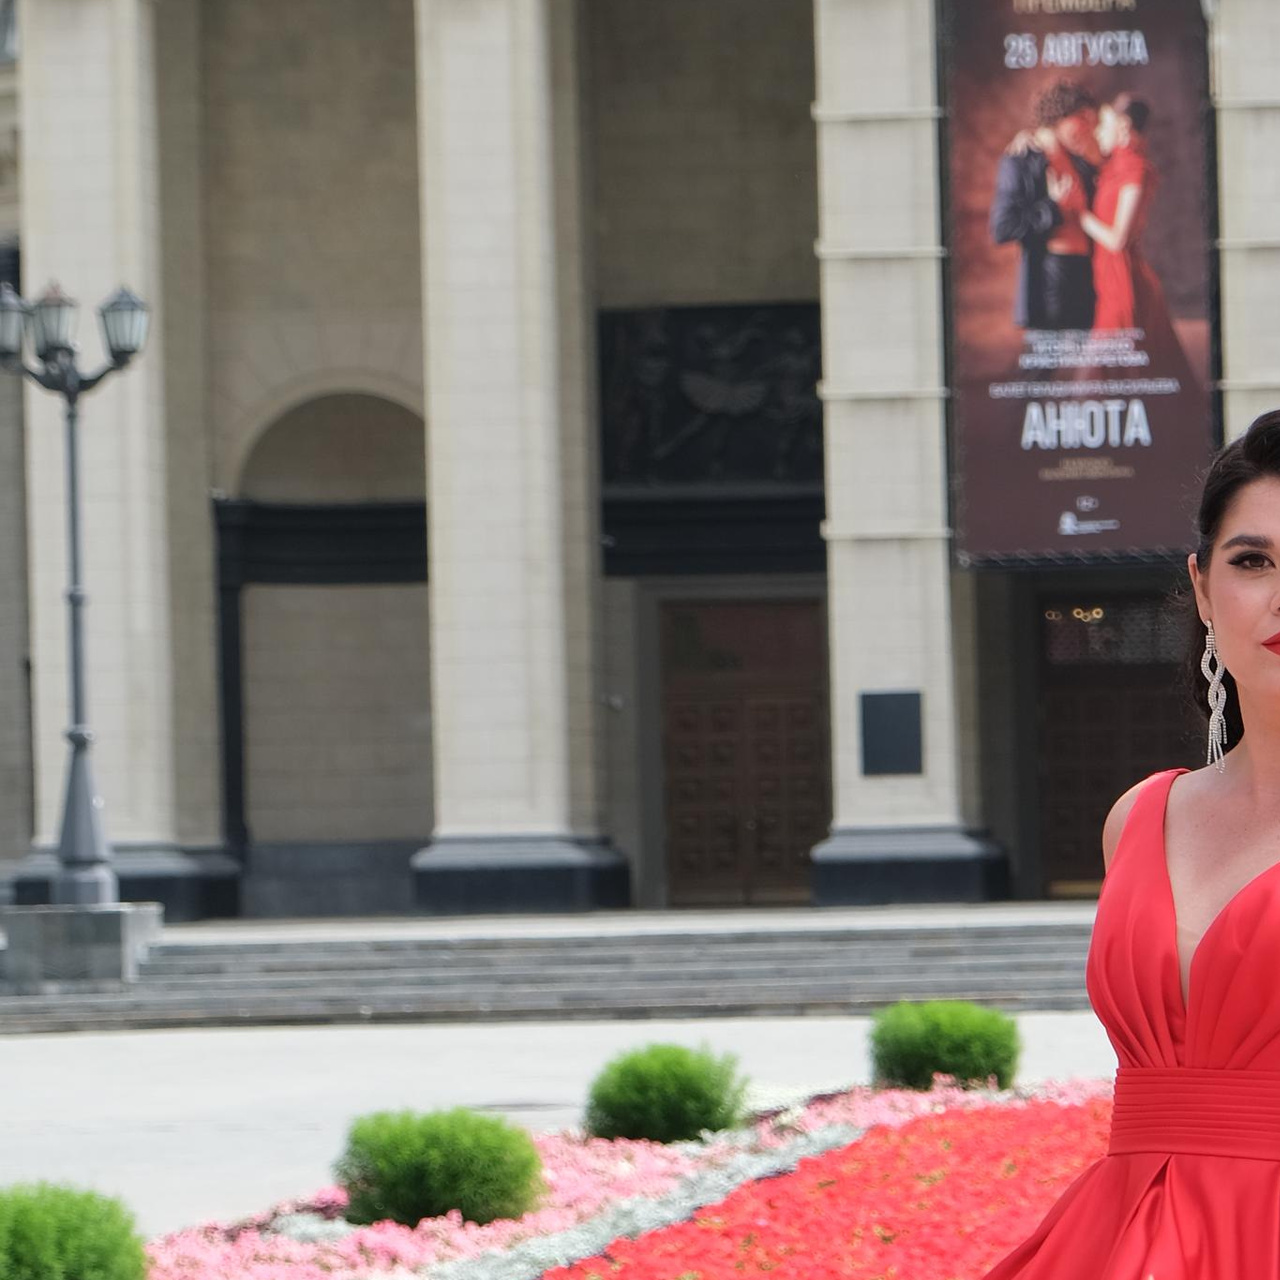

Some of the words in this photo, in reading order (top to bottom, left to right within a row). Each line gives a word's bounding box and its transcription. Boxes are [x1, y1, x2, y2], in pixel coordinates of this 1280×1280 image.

[1004, 34, 1038, 68] 25
[1042, 30, 1149, 66] АВГУСТА
[1021, 399, 1152, 450] АНЮТА
